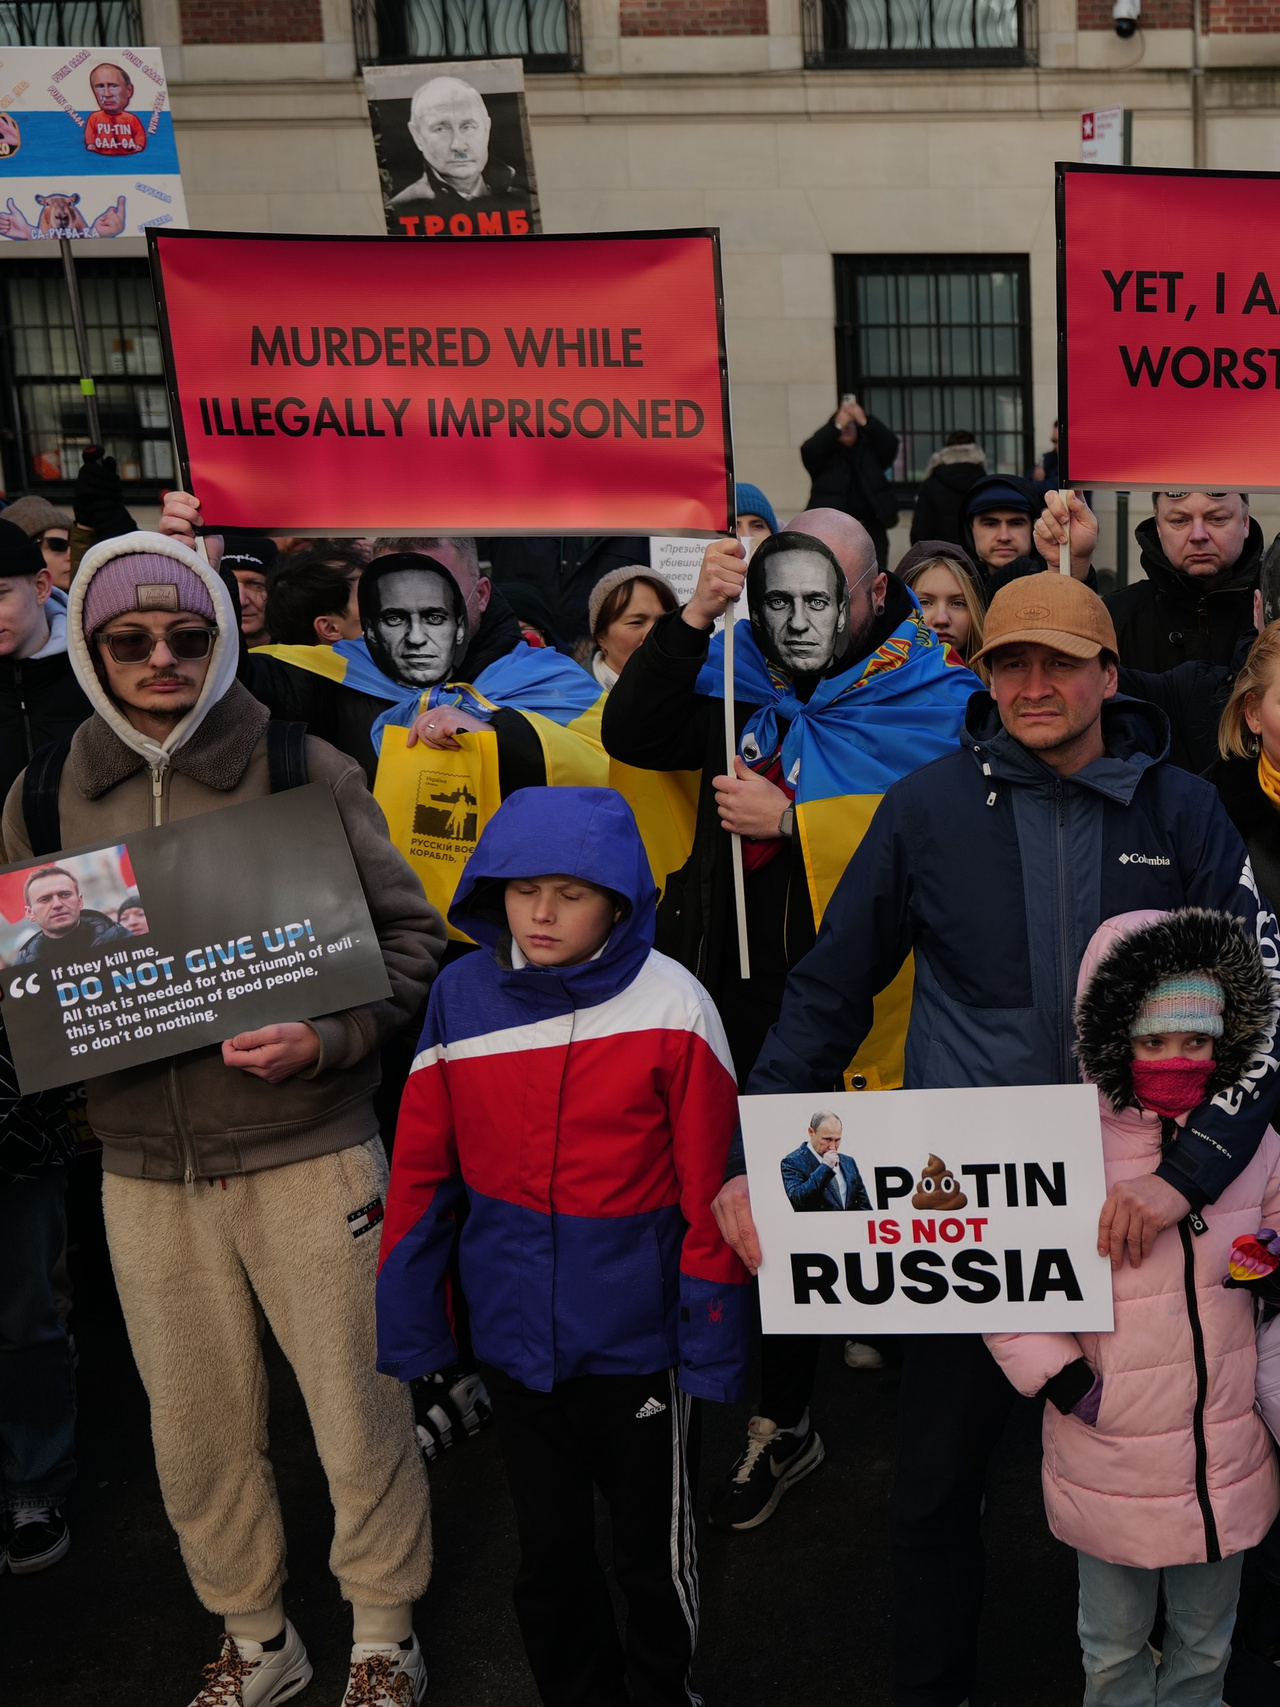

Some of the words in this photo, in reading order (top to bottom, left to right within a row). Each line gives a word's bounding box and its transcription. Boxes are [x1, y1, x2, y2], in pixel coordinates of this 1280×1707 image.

[95, 138, 136, 149] GAA-GA
[97, 123, 131, 135] PU-TIN
[30, 227, 100, 240] CA-PY-BA-RA
[398, 209, 529, 235] ТРОМБ
[1101, 269, 1198, 322] YET,
[1215, 271, 1226, 314] I
[250, 325, 492, 367] MURDERED
[503, 327, 644, 368] WHILE
[199, 396, 411, 437] ILLEGALLY
[427, 397, 705, 439] IMPRISONED
[660, 544, 706, 555] «Президе
[410, 847, 457, 863] КОРАБЛЬ,
[411, 838, 453, 852] РУССКІЙ
[454, 845, 476, 854] ВОЄ
[51, 967, 64, 981] If
[67, 958, 101, 977] they
[104, 951, 129, 967] kill
[131, 947, 159, 961] me,
[56, 976, 103, 1007] DO
[111, 956, 175, 993] NOT
[185, 935, 256, 973] GIVE
[262, 919, 316, 952] UP!
[62, 1008, 82, 1024] All
[85, 1000, 118, 1017] that
[121, 996, 134, 1009] is
[136, 980, 193, 1004] needed
[195, 975, 216, 989] for
[220, 967, 246, 982] the
[248, 951, 306, 975] triumph
[309, 944, 324, 958] of
[327, 937, 352, 953] evil
[65, 1023, 95, 1040] this
[99, 1018, 112, 1032] is
[115, 1012, 141, 1028] the
[144, 995, 204, 1020] inaction
[208, 988, 223, 1002] of
[226, 978, 262, 1000] good
[265, 965, 319, 990] people,
[70, 1043, 88, 1056] so
[134, 1024, 153, 1039] do
[156, 1009, 219, 1034] nothing.
[867, 1219, 901, 1245] IS
[912, 1218, 988, 1243] NOT
[790, 1248, 1084, 1305] RUSSIA
[636, 1404, 666, 1418] adidas
